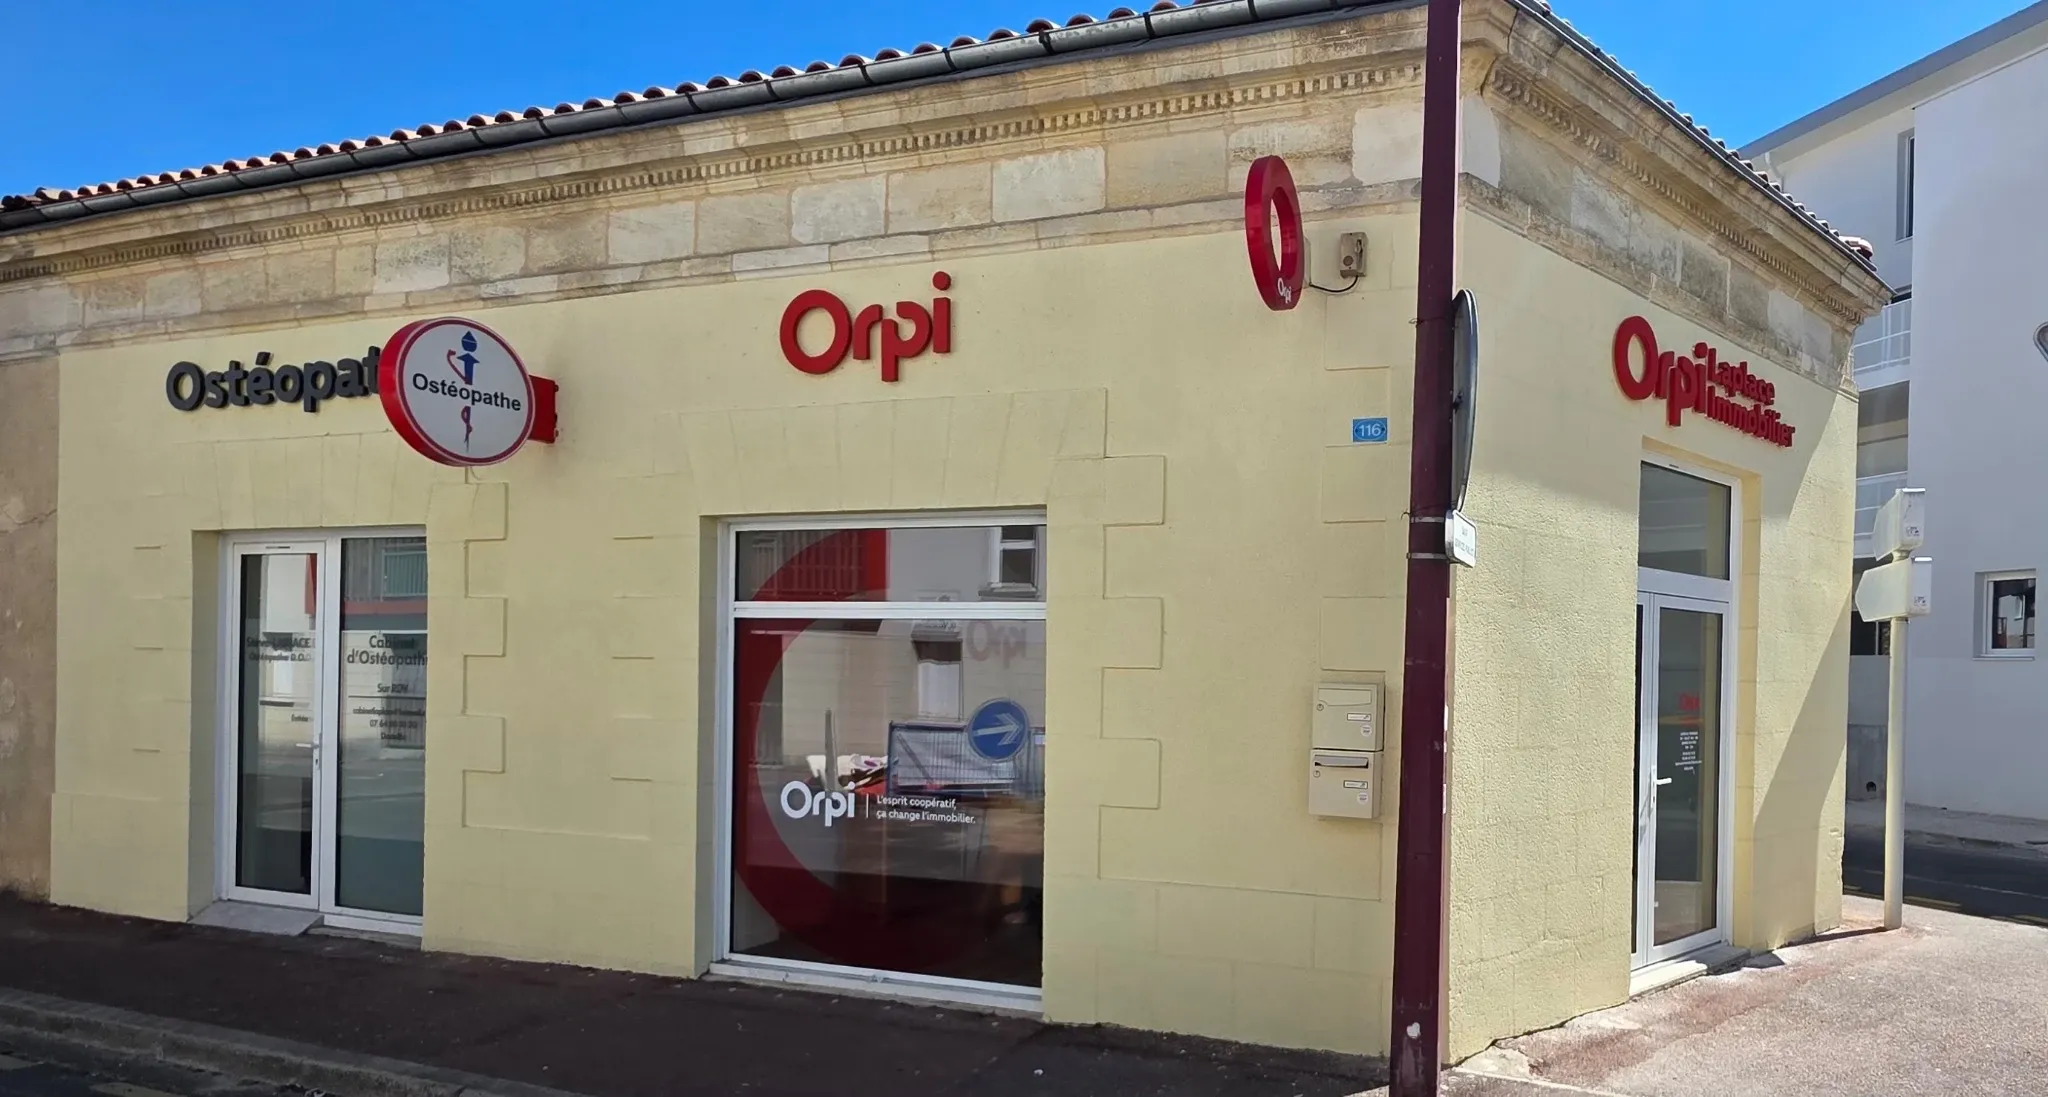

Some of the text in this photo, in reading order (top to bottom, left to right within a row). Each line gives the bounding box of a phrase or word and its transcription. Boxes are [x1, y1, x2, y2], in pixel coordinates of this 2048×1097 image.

[1277, 277, 1292, 304] Orpi
[780, 271, 951, 382] Orpi
[1613, 315, 1708, 427] Orpi
[1707, 348, 1775, 406] Laplace
[412, 372, 522, 412] Ostéopathe
[1358, 423, 1382, 438] 116
[1707, 385, 1796, 448] Immobilier
[369, 634, 415, 650] Cabit
[780, 780, 856, 827] Orpi
[876, 795, 957, 811] L'esprit coopératif,
[876, 809, 976, 824] ça change l'immobilier.
